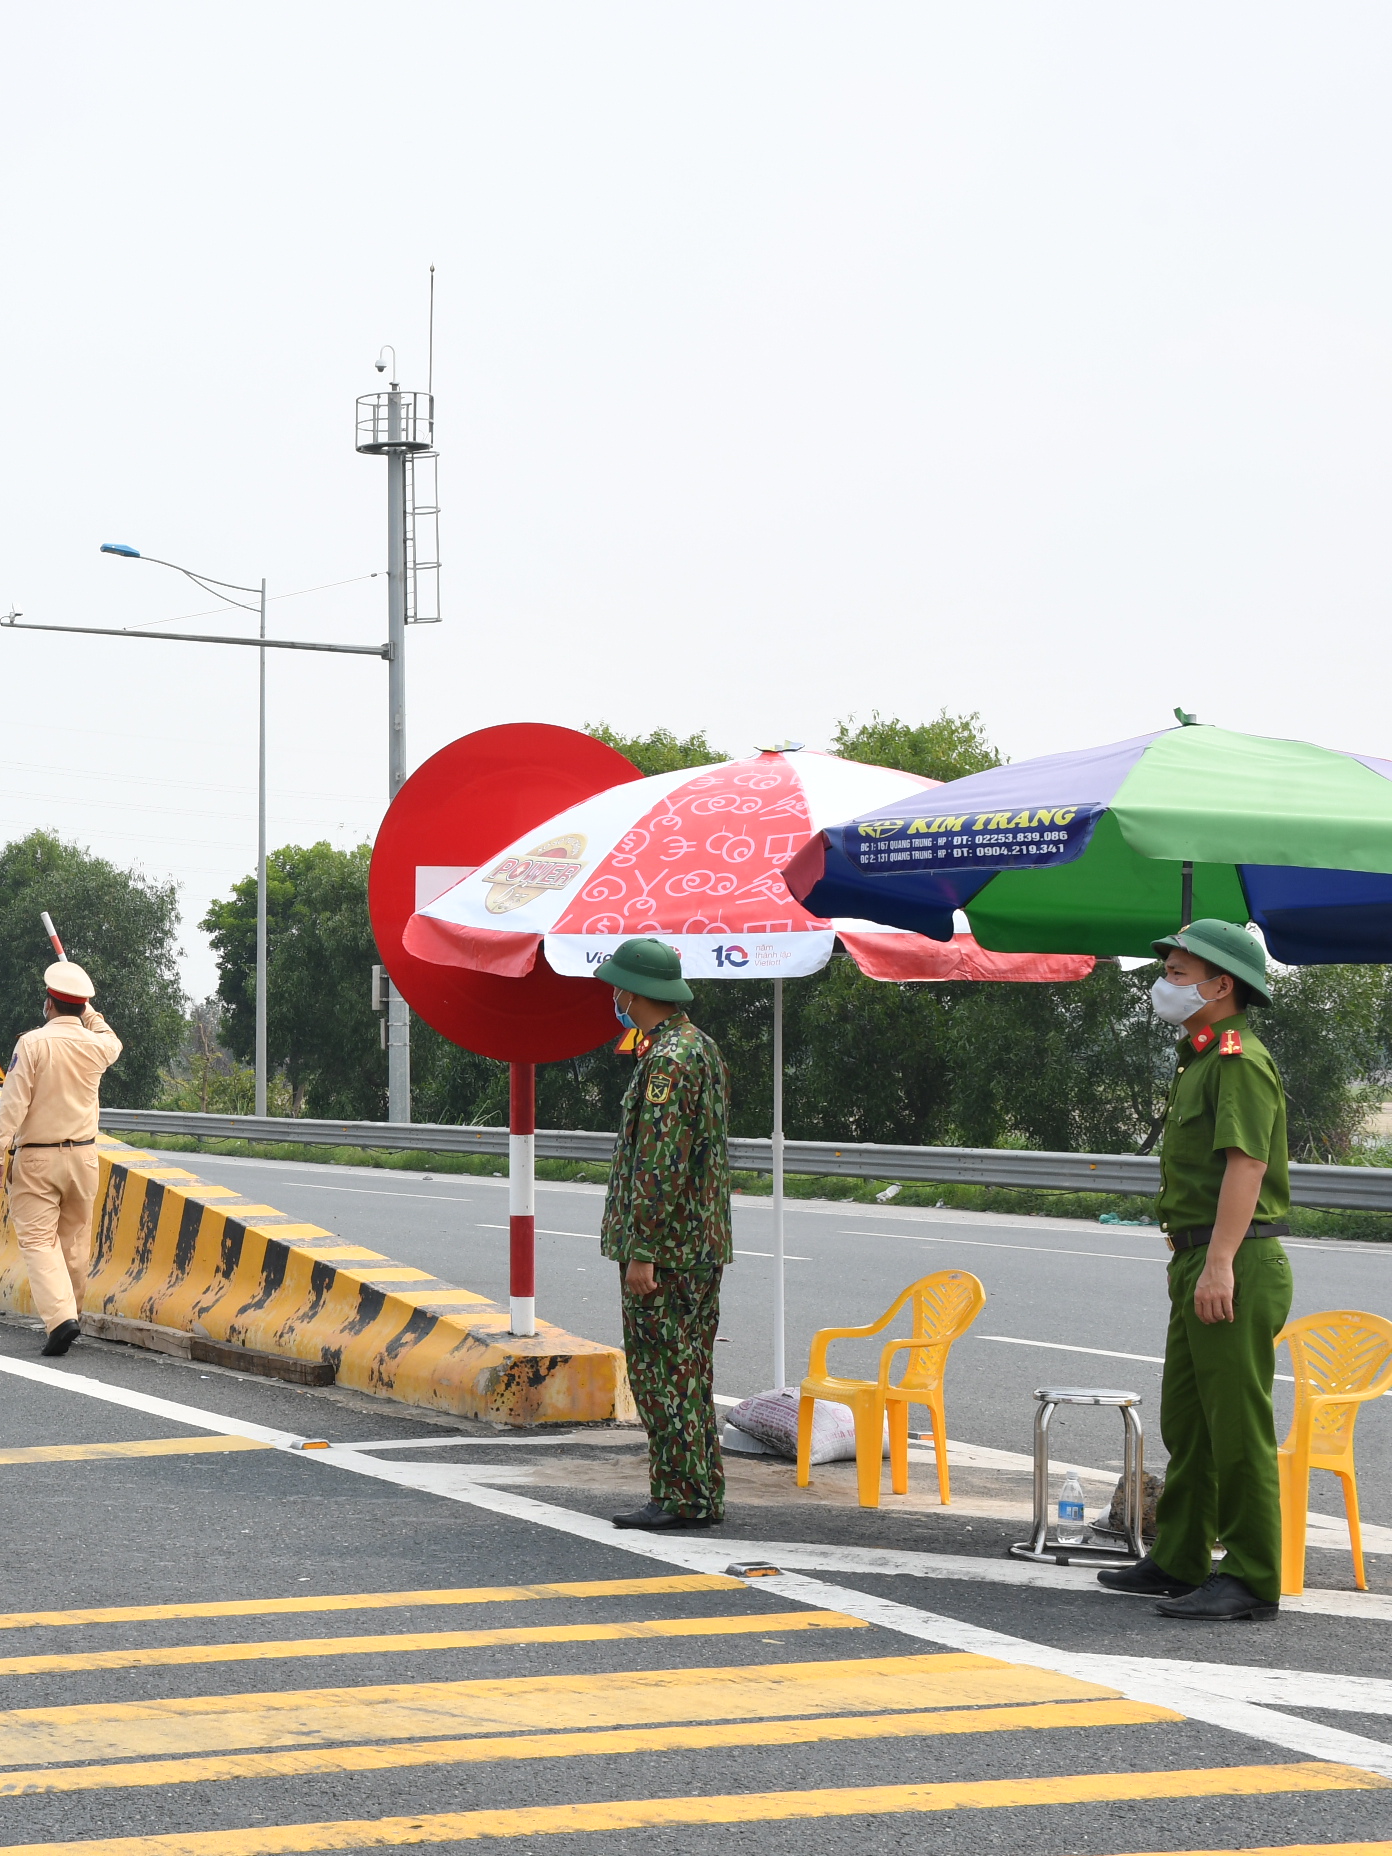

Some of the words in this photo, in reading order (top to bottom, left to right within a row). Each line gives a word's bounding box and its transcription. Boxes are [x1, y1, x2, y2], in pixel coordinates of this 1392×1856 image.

[907, 815, 970, 834] KIM
[971, 806, 1079, 831] TRANG
[889, 839, 911, 850] QUANG
[911, 837, 933, 848] TRUNG
[937, 837, 947, 846] HP
[974, 830, 1068, 844] 02253.839.086
[877, 853, 888, 863] 131
[889, 851, 911, 862] QUANG
[911, 850, 933, 860] TRUNG
[937, 849, 947, 859] HP
[976, 843, 1065, 857] 0904.219.341
[488, 857, 582, 887] POWER
[711, 945, 750, 968] 10
